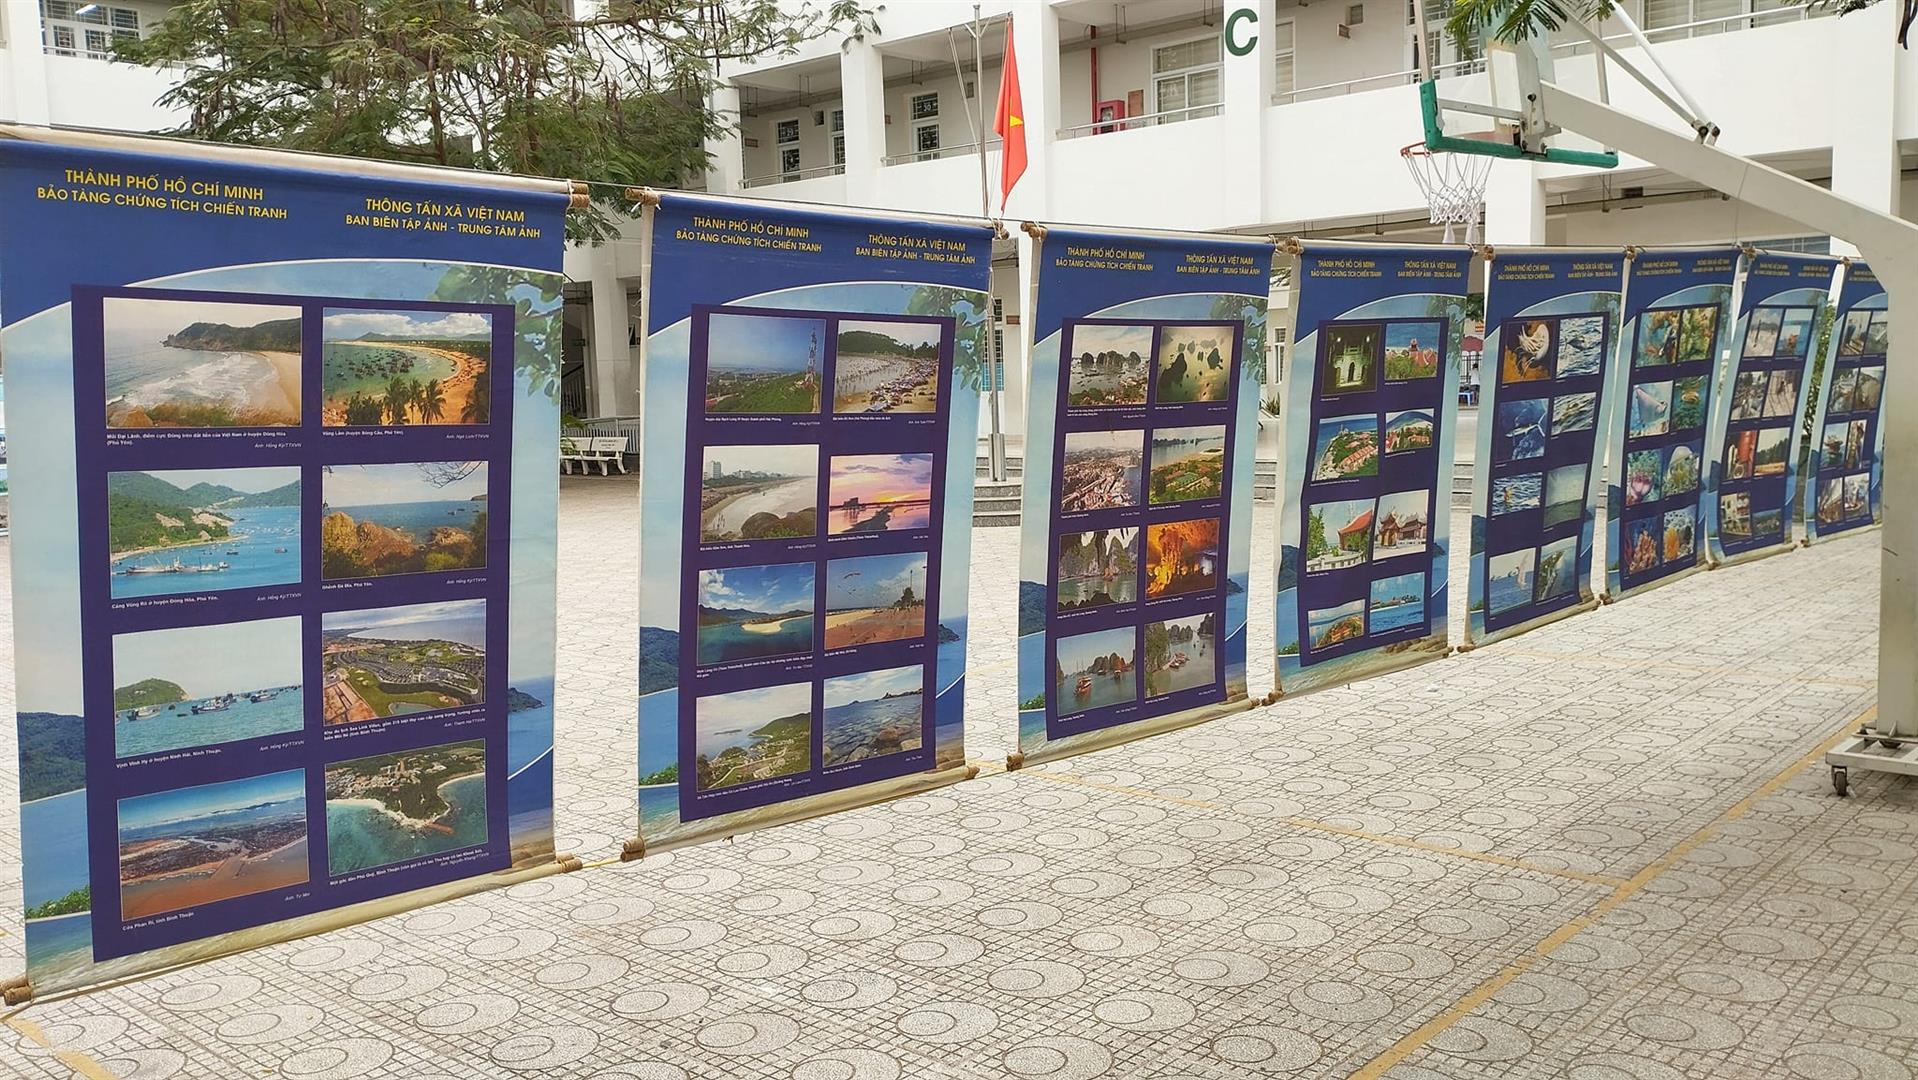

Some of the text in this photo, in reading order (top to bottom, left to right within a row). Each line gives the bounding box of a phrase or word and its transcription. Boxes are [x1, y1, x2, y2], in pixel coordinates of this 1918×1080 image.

[1225, 8, 1258, 56] C
[65, 168, 263, 200] THÀNH PHỐ HỒ CHÍ MINH
[38, 184, 287, 219] BẢO TÀNG CHỨNG TÍCH CHIẾN TRANH
[366, 198, 524, 222] THÔNG TẤN XÃ VIỆT NAM
[346, 215, 369, 225] BAN
[373, 215, 399, 228] BIÊN
[402, 218, 421, 230] TẬP
[424, 218, 447, 231] ẢNH
[458, 224, 492, 235] TRUNG
[495, 223, 516, 236] TÂM
[519, 224, 540, 238] ẢNH
[694, 216, 808, 238] THÀNH PHỐ HỒ CHÍ MINH
[676, 228, 821, 251] BẢO TÀNG CHỨNG TÍCH CHIẾN TRANH
[869, 233, 965, 251] THÔNG TẤN XÃ VIỆT NAM
[872, 248, 888, 257] BIÊN
[889, 250, 901, 258] TẬP
[903, 249, 917, 259] ẢNH
[924, 253, 944, 261] TRUNG
[946, 252, 959, 262] TÂM
[961, 254, 975, 264] ẢNH
